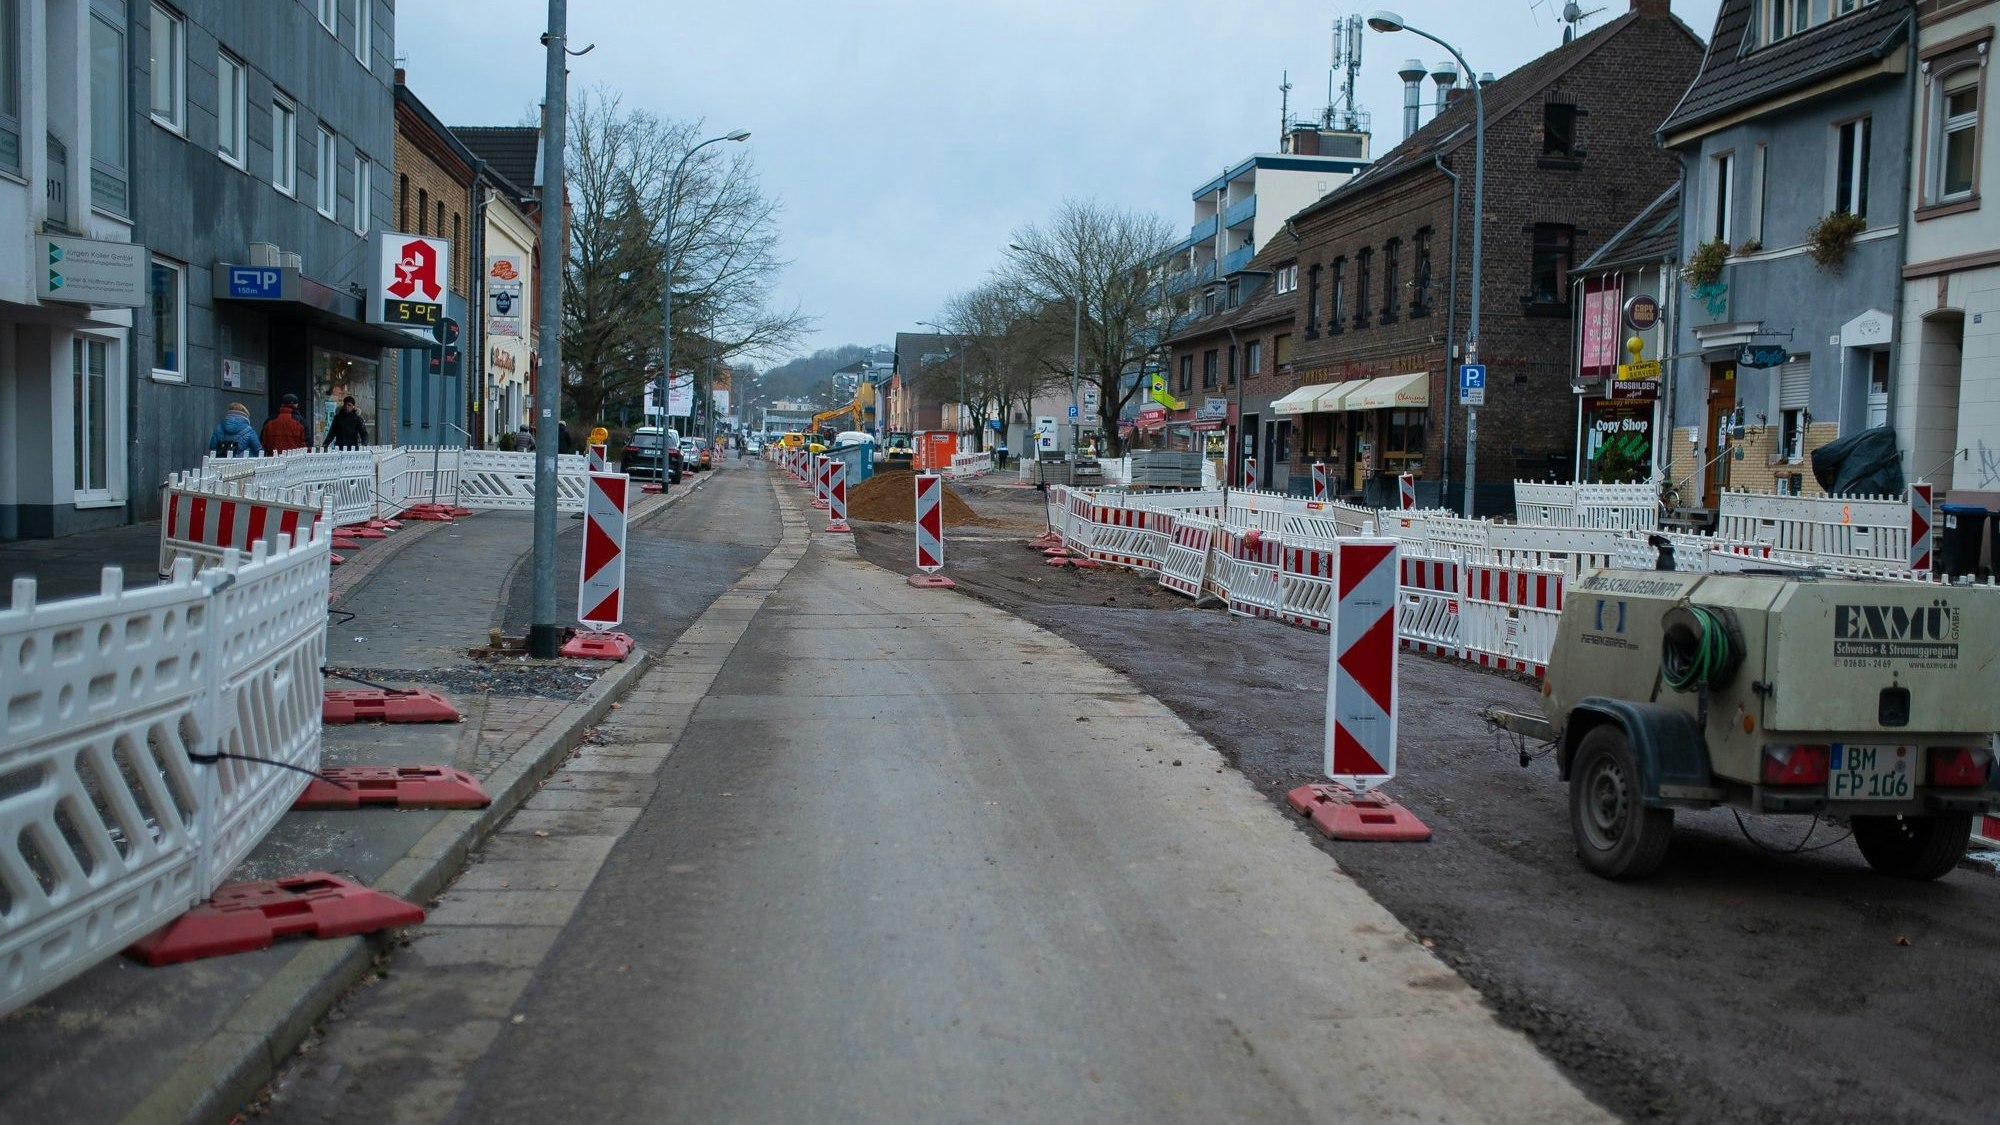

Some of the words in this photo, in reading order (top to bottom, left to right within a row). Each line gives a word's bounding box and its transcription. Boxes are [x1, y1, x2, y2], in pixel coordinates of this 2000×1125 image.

[263, 271, 278, 290] P
[400, 303, 410, 320] 5
[1635, 304, 1654, 313] COPY
[1592, 313, 1609, 327] PASS
[1628, 362, 1656, 372] STEMPEL
[1629, 369, 1657, 378] SERVICE
[1466, 368, 1480, 387] P
[1614, 381, 1656, 391] PASSBILDER
[1070, 407, 1077, 416] P
[1596, 419, 1620, 434] Copy
[1622, 418, 1648, 434] Shop
[1834, 599, 1952, 641] EXMÜ
[1951, 606, 1960, 641] GMBH
[1835, 642, 1878, 655] Schweiss-
[1880, 643, 1887, 655] &
[1889, 643, 1957, 659] Stromaggregate
[1848, 747, 1877, 771] BM
[1835, 773, 1864, 797] FP
[1868, 773, 1908, 797] 106
